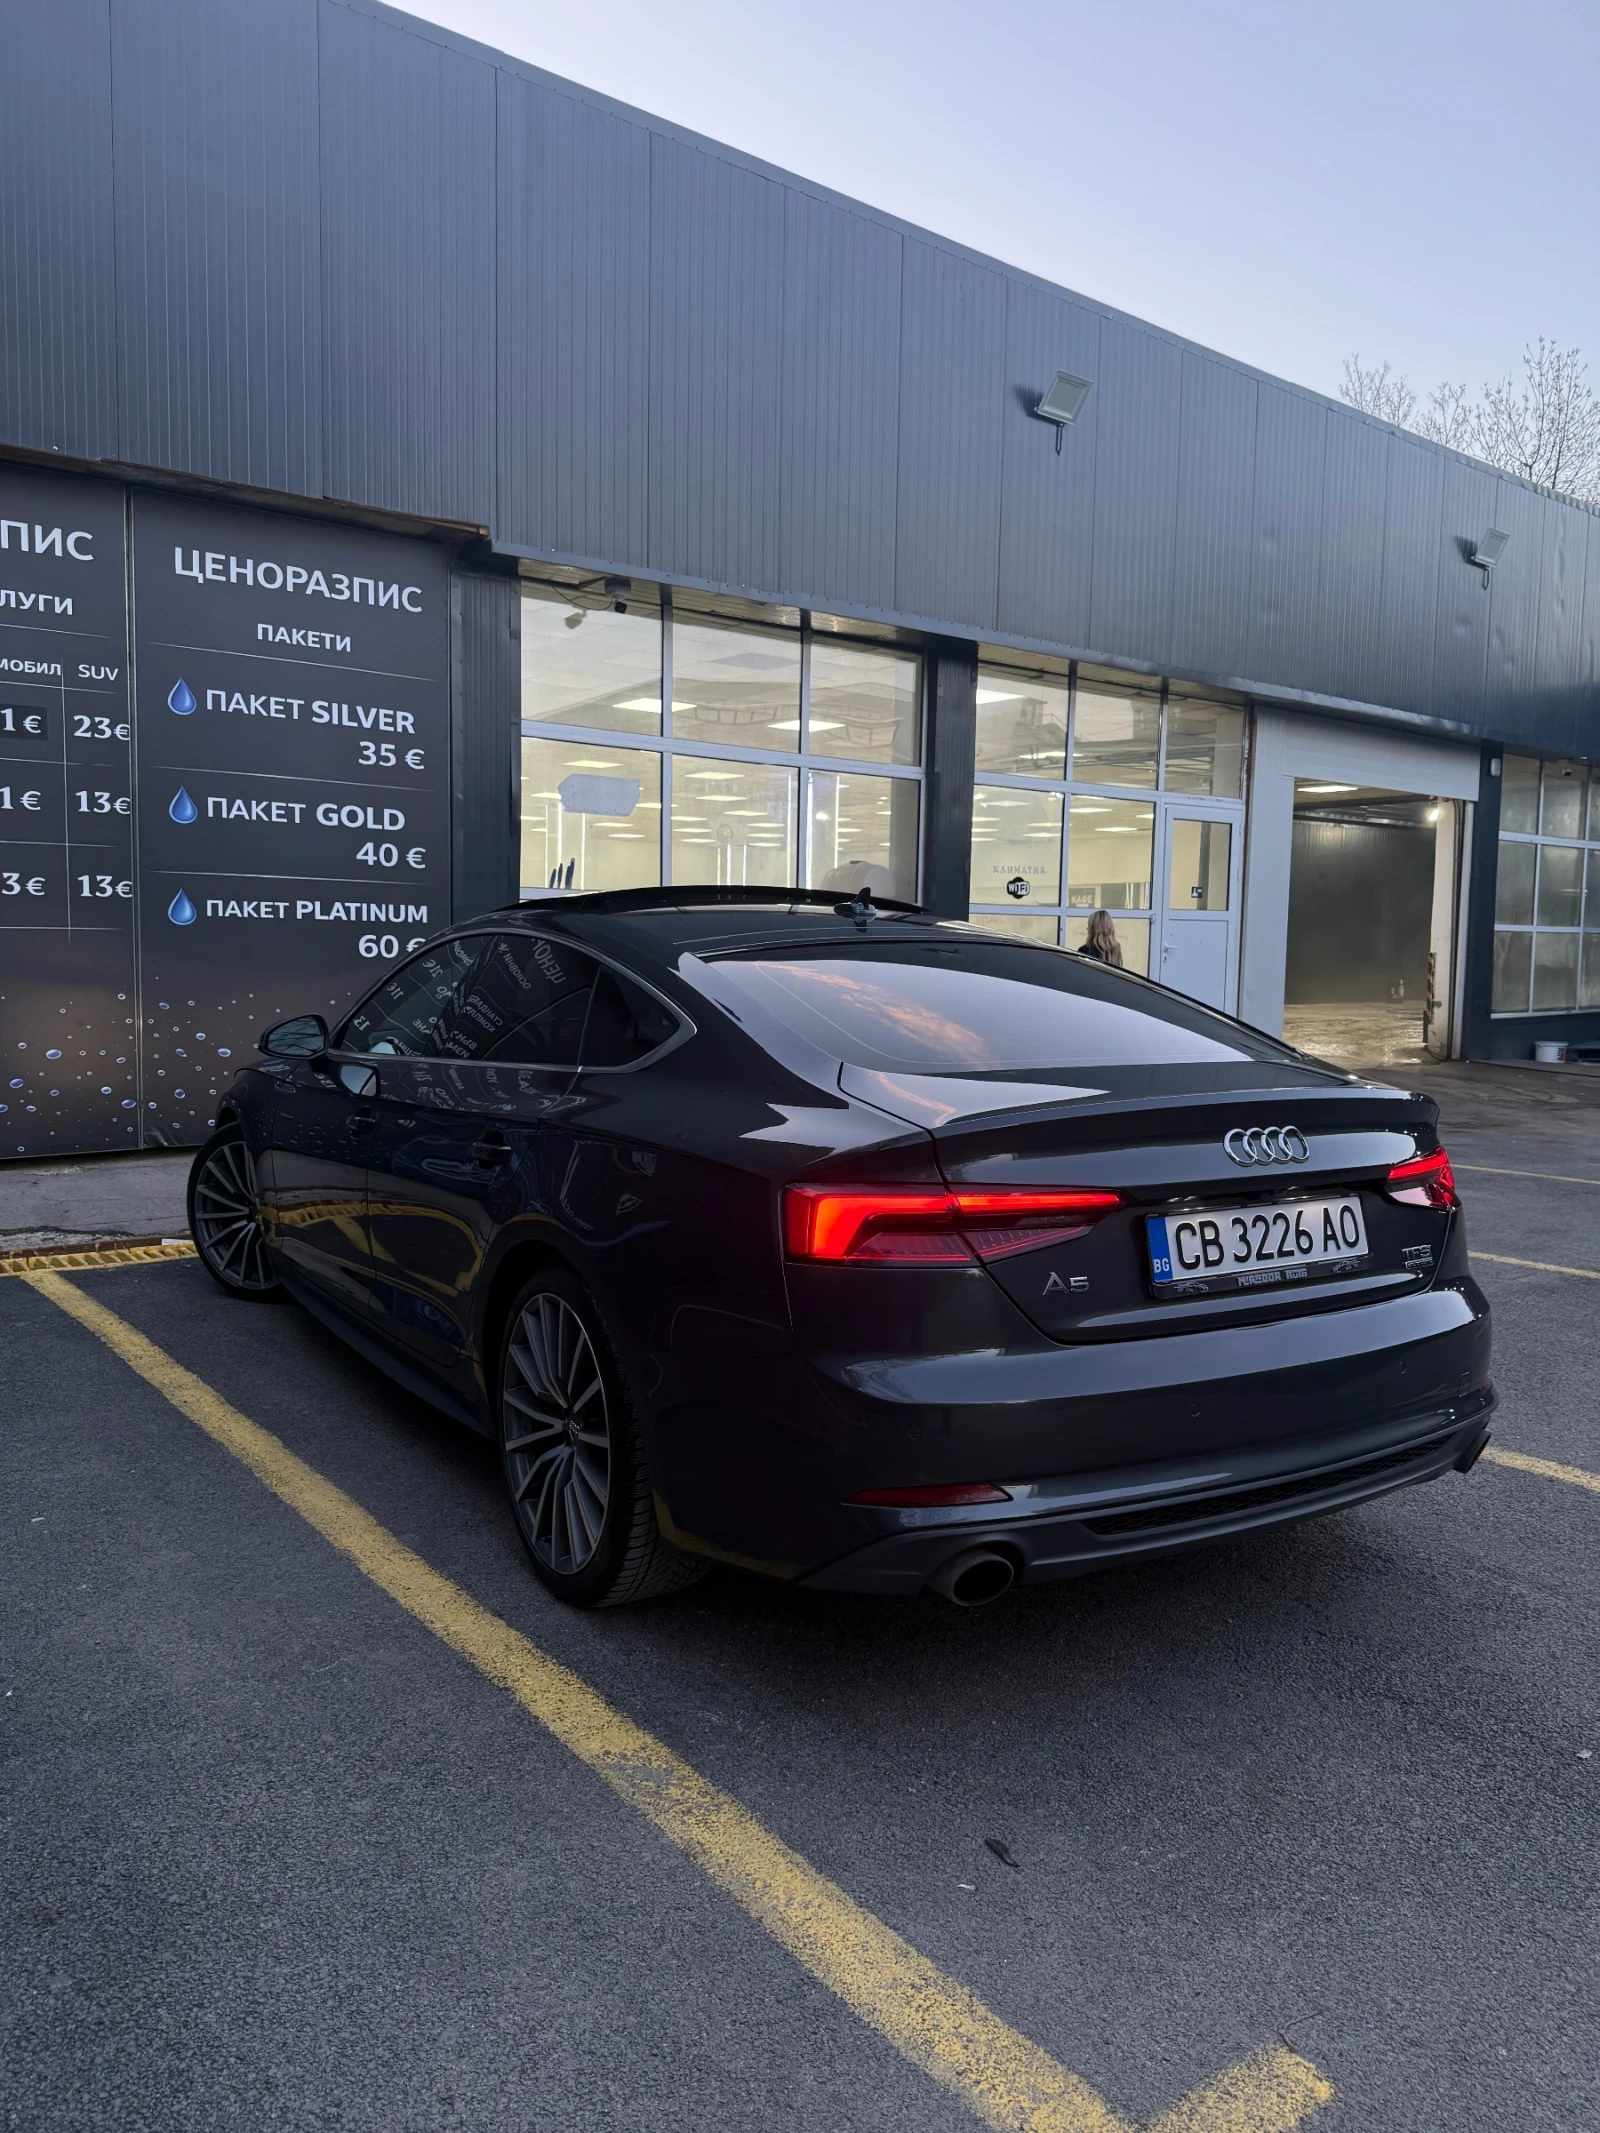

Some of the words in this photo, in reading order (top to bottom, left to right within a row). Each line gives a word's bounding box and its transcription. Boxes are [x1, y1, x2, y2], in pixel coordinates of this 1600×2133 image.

[1, 519, 94, 561] ПИС
[174, 547, 422, 613] ЦЕНОРАЗПИС
[257, 623, 351, 653] ПАКЕТИ
[78, 664, 119, 681] SUV
[206, 689, 304, 720] ПАКЕТ
[311, 700, 415, 734] SILVER
[358, 741, 397, 767] 35
[405, 749, 425, 770] €
[207, 797, 306, 824] ПАКЕТ
[316, 803, 406, 831] GOLD
[356, 842, 399, 867] 40
[406, 848, 426, 869] €
[206, 900, 290, 919] ПАКЕТ
[296, 900, 428, 924] PLATINUM
[1071, 894, 1093, 904] КАФЕ
[358, 934, 399, 958] 60
[1175, 1219, 1225, 1270] CB
[1232, 1210, 1314, 1263] 3226
[1321, 1205, 1360, 1252] AO
[1153, 1257, 1170, 1274] BG
[1042, 1271, 1089, 1296] A5
